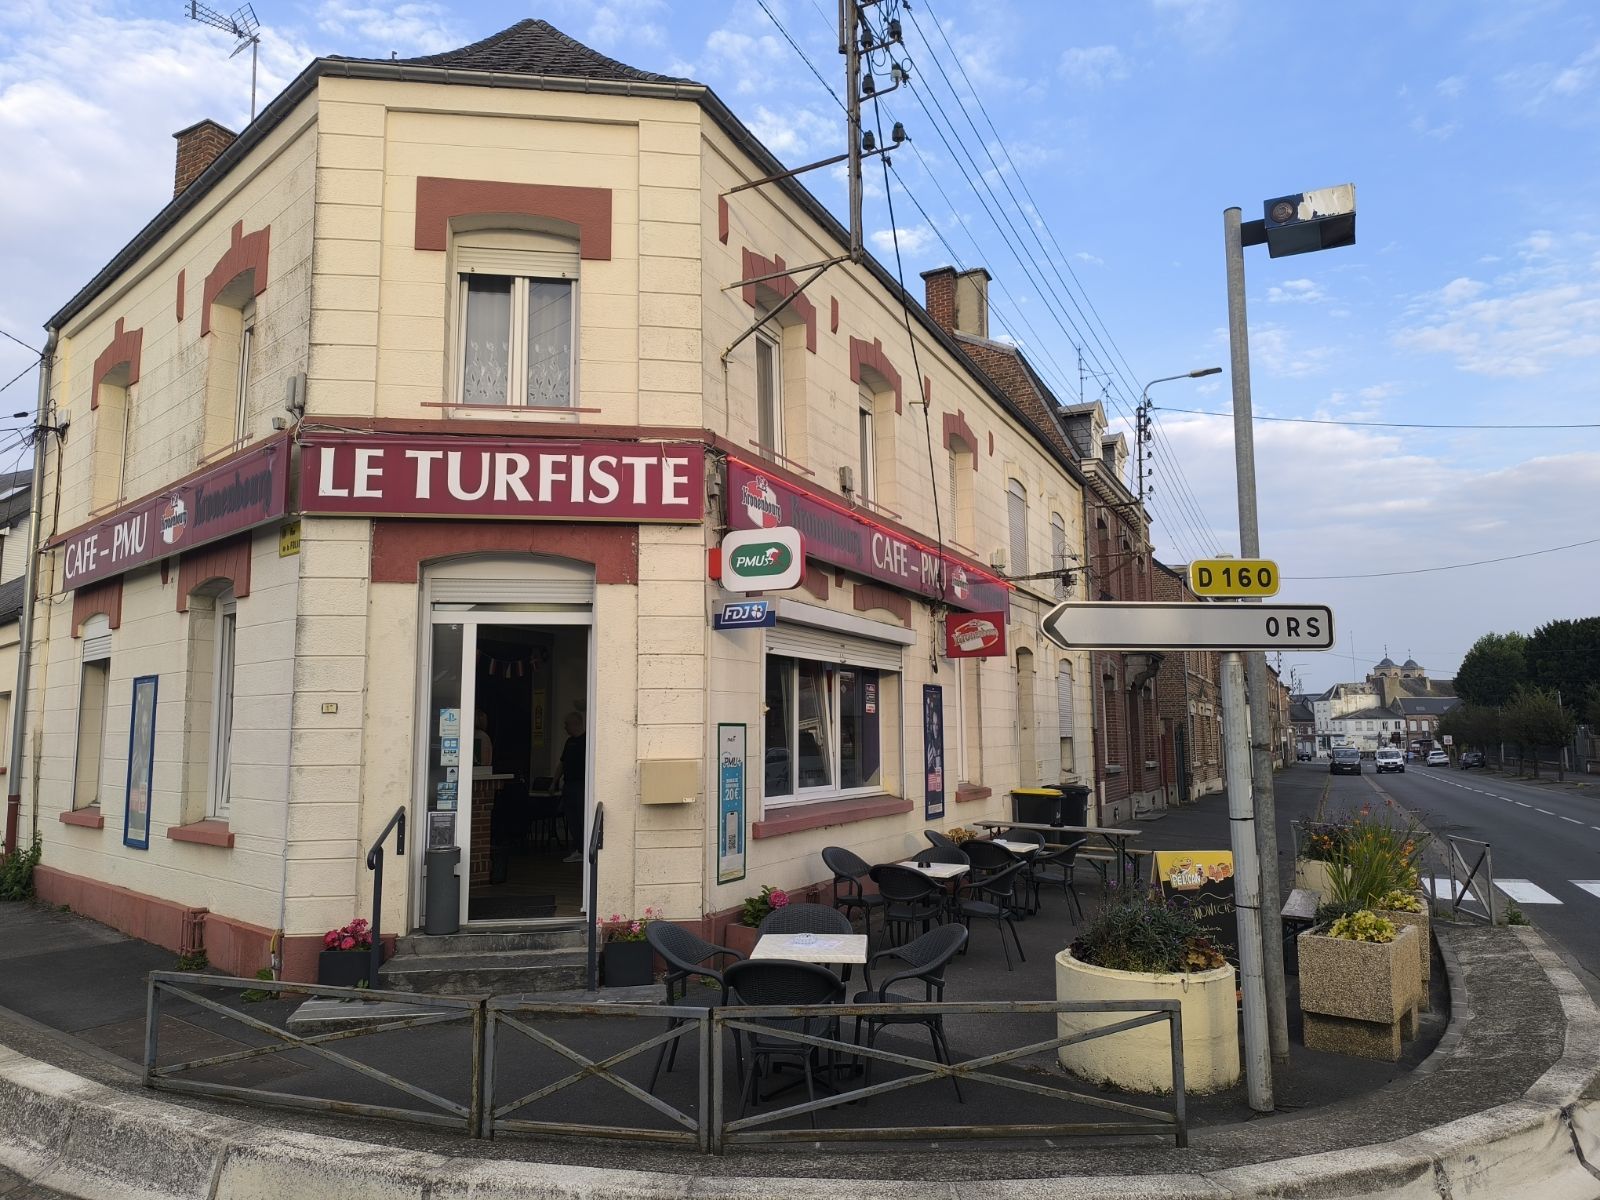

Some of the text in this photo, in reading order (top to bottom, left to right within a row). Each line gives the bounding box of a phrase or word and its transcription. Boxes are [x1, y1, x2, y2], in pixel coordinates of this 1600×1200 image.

[319, 447, 689, 505] LE TURFISTE
[741, 485, 782, 523] Kronenbourg
[65, 534, 98, 579] CAFE
[112, 512, 147, 562] PMU
[736, 556, 764, 567] PMU
[872, 532, 908, 577] CAFE
[920, 552, 947, 591] PMU
[1198, 567, 1272, 588] D 160
[724, 606, 750, 620] FDJ
[1265, 616, 1321, 638] ORS
